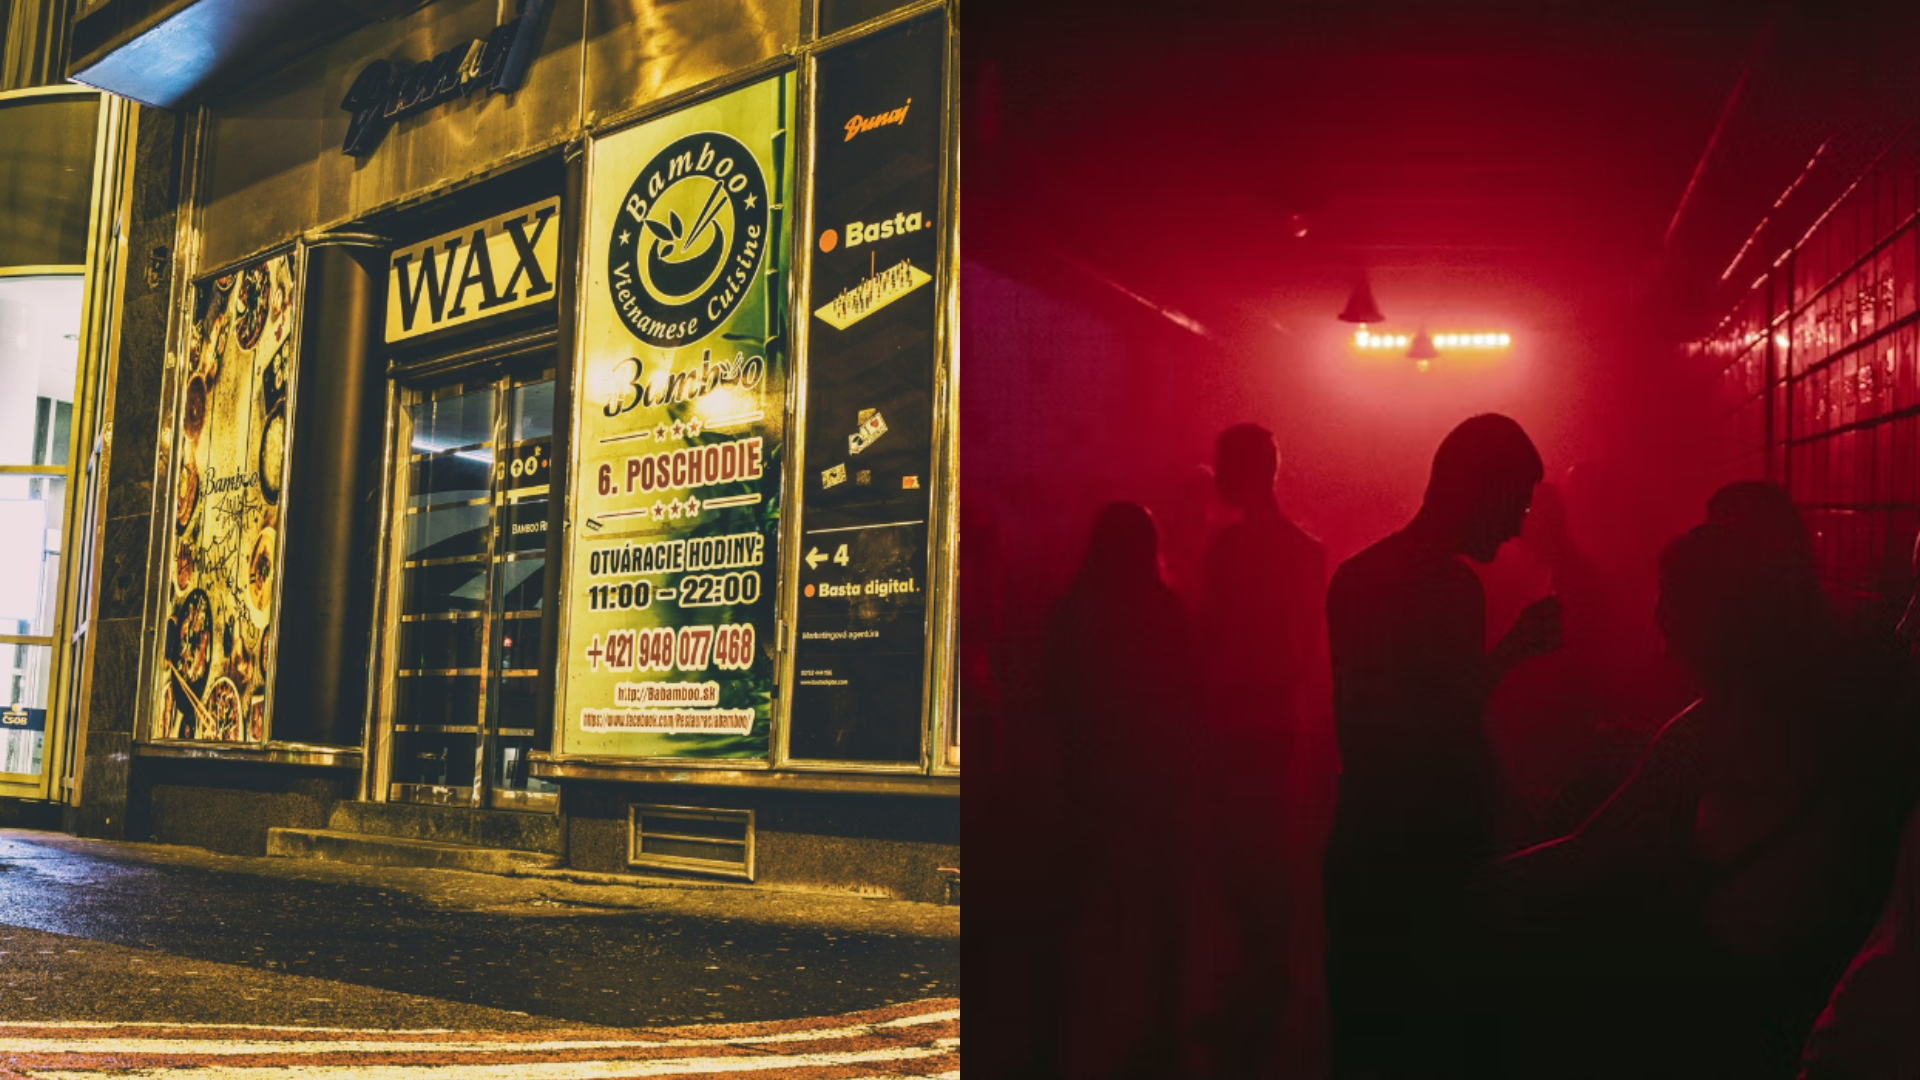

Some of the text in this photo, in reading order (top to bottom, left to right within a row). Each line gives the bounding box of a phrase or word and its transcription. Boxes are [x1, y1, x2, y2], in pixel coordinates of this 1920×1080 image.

[844, 98, 912, 142] Dunaj
[626, 141, 748, 223] Bamboo
[393, 204, 557, 332] WAX
[613, 224, 761, 340] Vietnamese Cuisine
[598, 440, 761, 496] 6. POSCHODIE
[590, 536, 761, 575] OTVÁRACIE HODINY:
[833, 544, 850, 566] 4
[589, 582, 650, 610] 11:00
[682, 574, 759, 604] 22:00
[819, 583, 860, 598] Basta
[639, 632, 673, 667] 948
[679, 630, 711, 666] 077
[716, 628, 751, 665] 468
